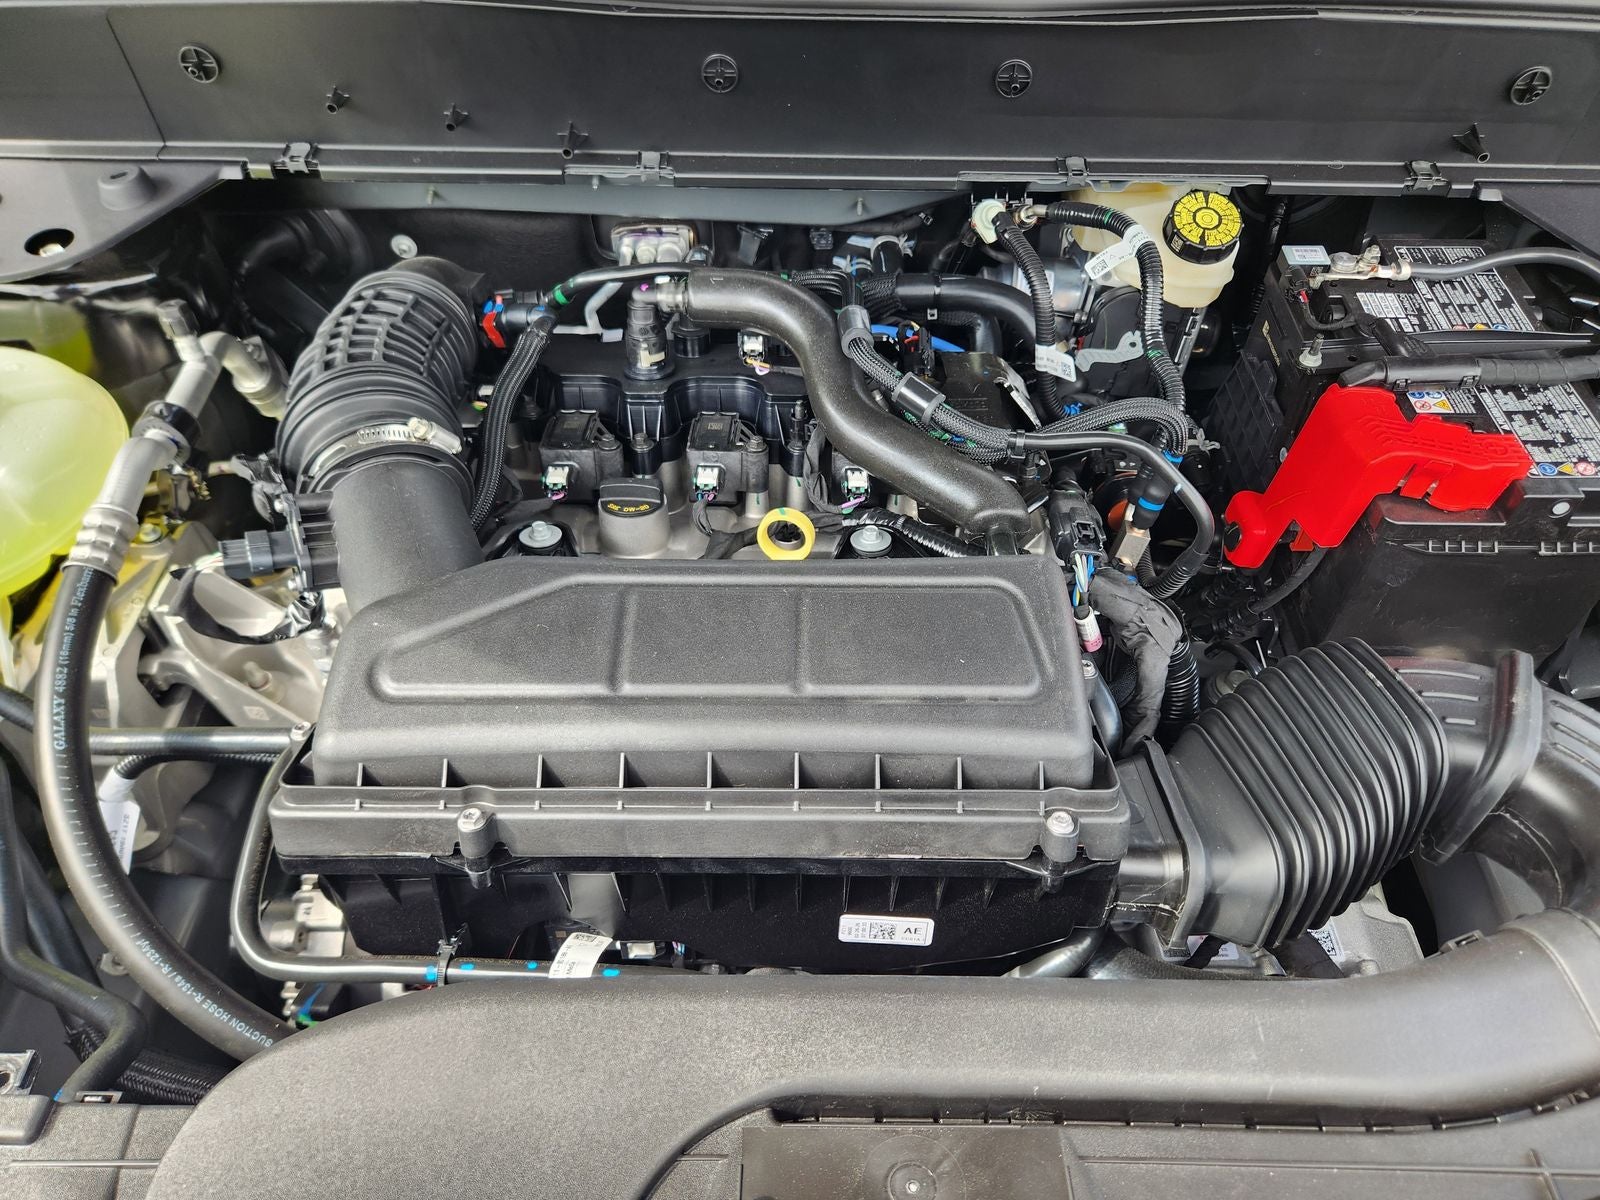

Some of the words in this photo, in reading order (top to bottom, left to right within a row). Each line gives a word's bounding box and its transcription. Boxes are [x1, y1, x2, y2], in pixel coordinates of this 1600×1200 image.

[65, 617, 77, 632] 5/8
[56, 668, 68, 693] 4882
[53, 696, 67, 750] GALAXY
[903, 927, 922, 935] AE
[174, 975, 206, 1004] R-134a
[202, 999, 231, 1023] HOSE
[229, 1017, 273, 1048] SUCTION
